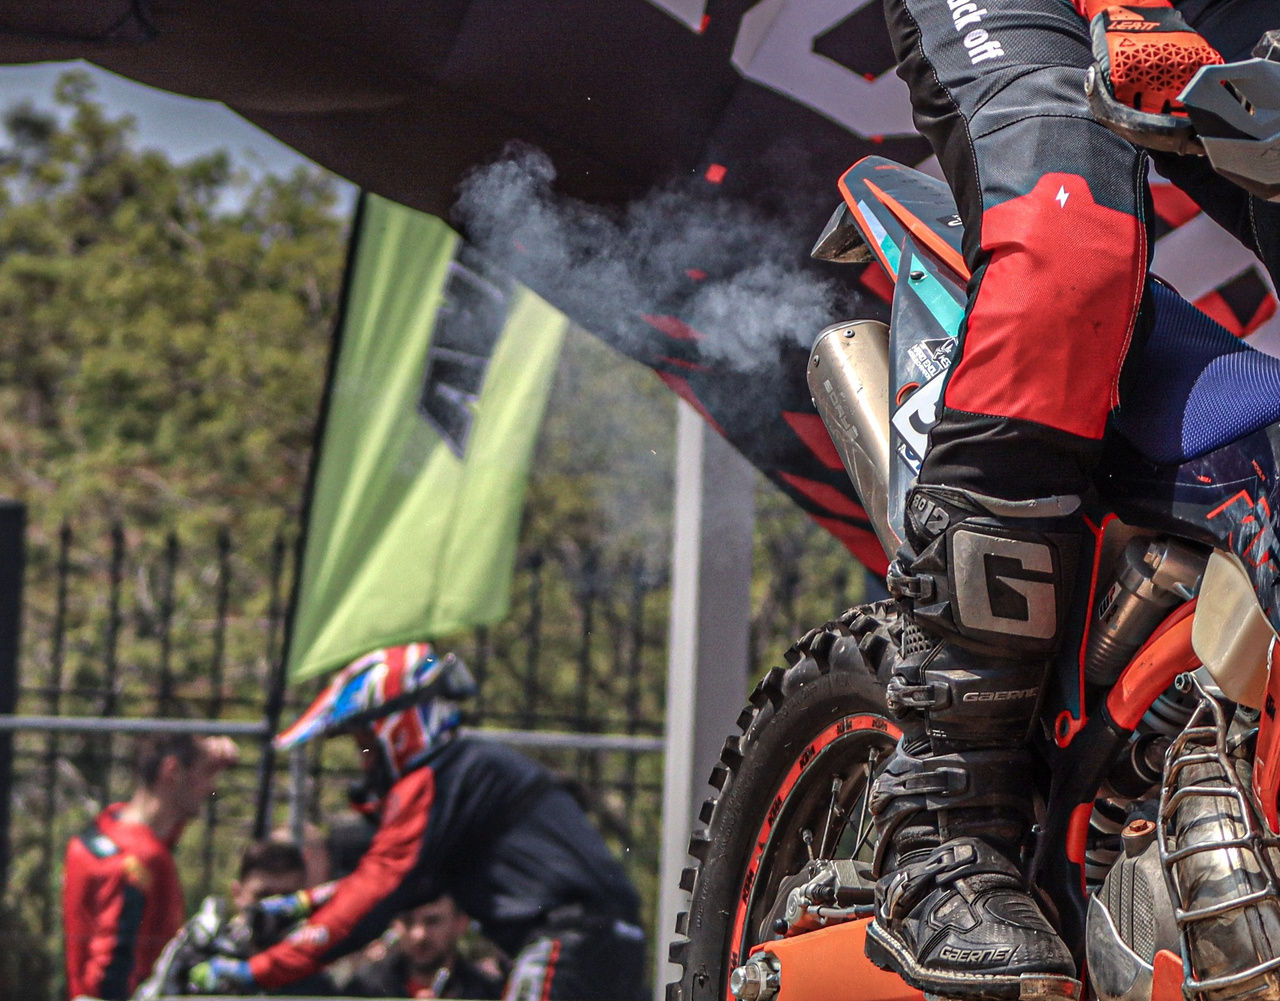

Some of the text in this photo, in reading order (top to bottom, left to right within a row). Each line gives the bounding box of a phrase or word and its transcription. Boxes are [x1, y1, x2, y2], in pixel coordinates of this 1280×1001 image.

[1107, 21, 1160, 31] LEATT
[963, 28, 1005, 65] off
[940, 945, 1011, 962] GAERNE
